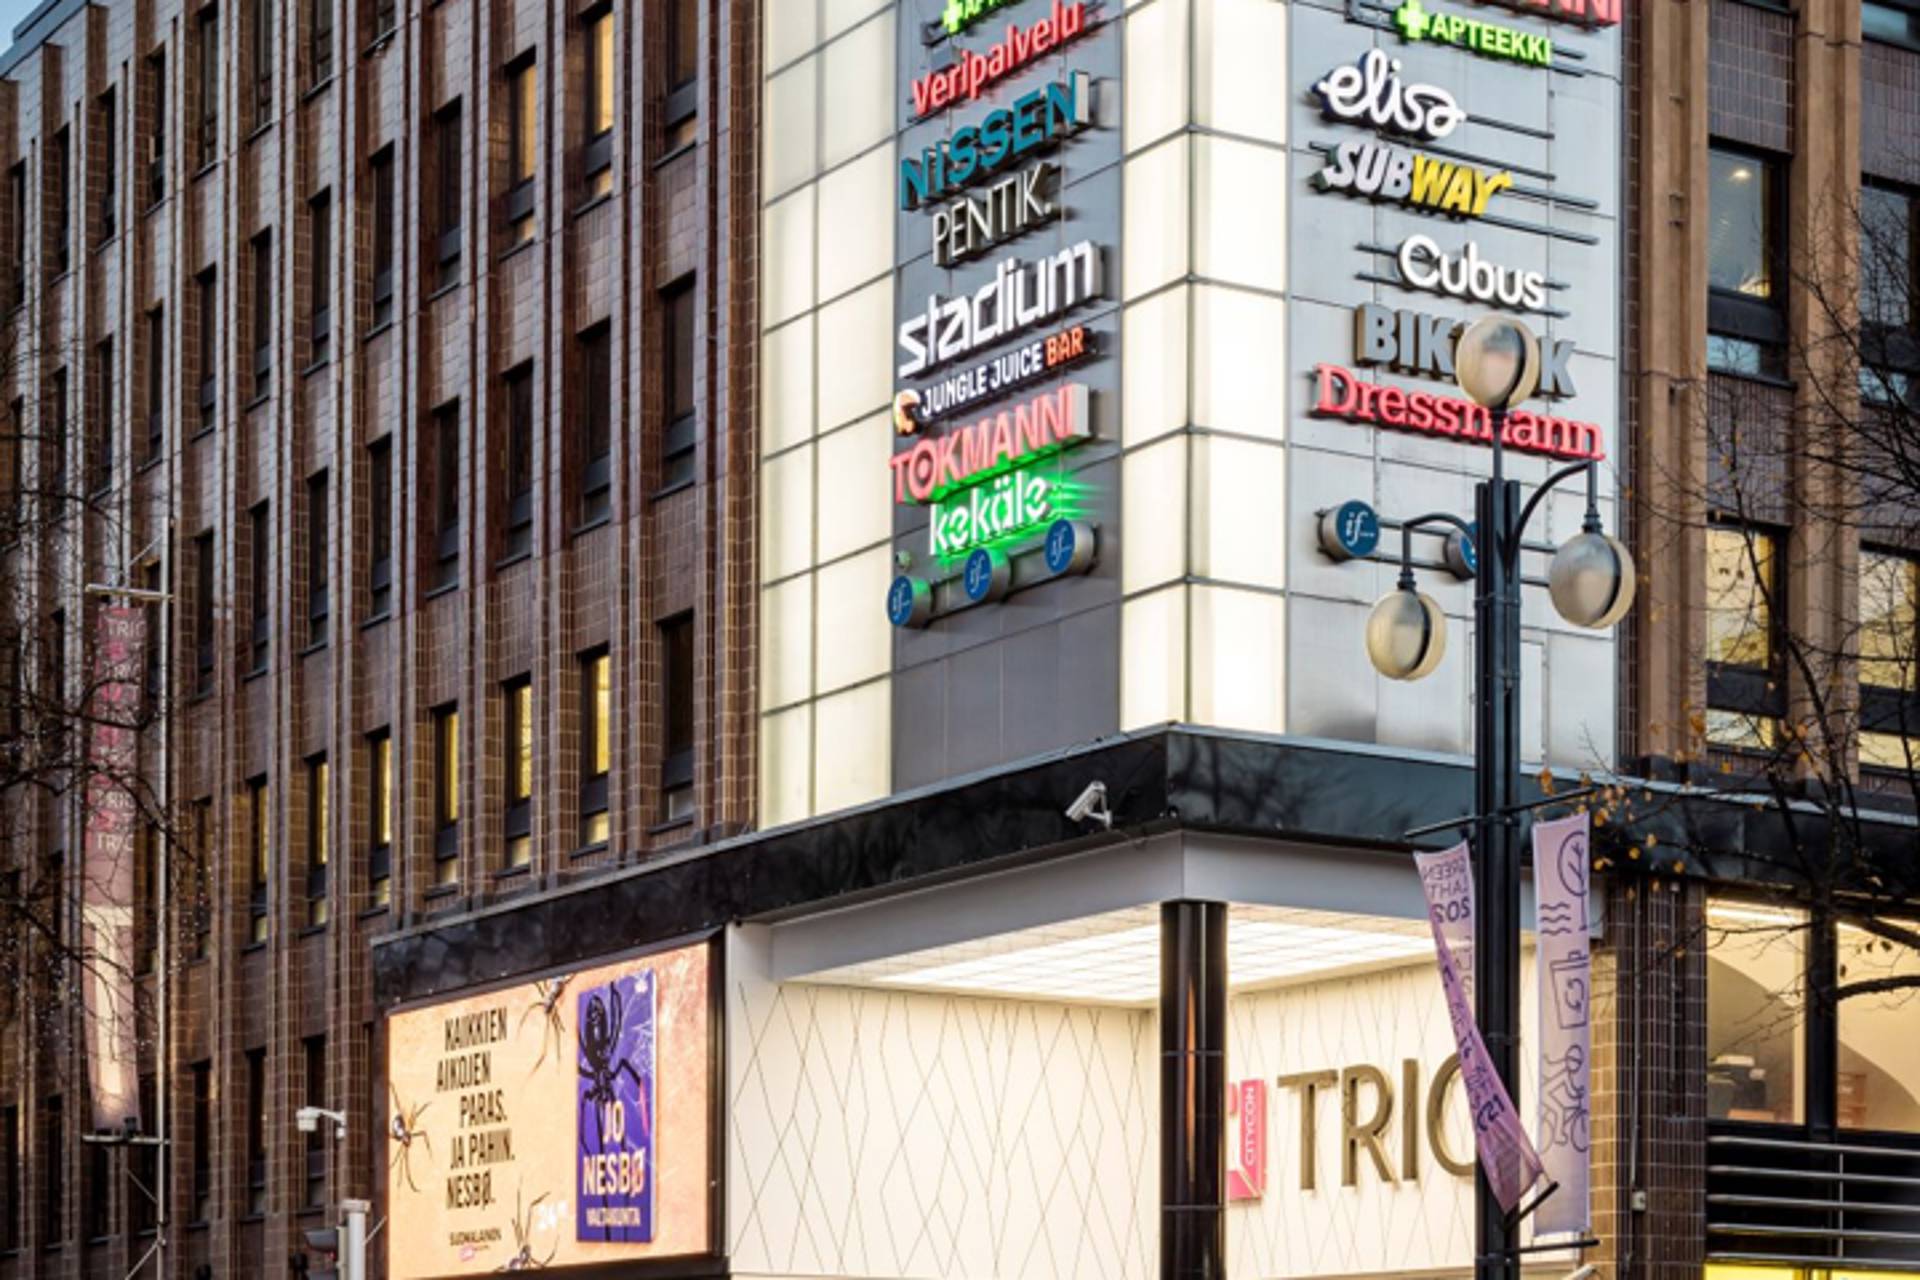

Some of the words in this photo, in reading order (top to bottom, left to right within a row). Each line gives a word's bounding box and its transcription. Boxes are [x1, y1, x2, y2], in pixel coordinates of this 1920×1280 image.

[911, 0, 1086, 116] Veripalvelu
[1430, 12, 1553, 64] APTEEKKI
[1318, 48, 1467, 137] elisa
[901, 69, 1088, 211] NISSEN
[1322, 141, 1513, 217] SUBWAY
[1401, 234, 1546, 309] Cubus
[921, 363, 987, 418] JUNGLE
[989, 343, 1043, 390] JUICE
[1045, 325, 1084, 366] BAR
[890, 383, 1088, 503] TOKMANNI
[930, 470, 1049, 555] kekäle
[436, 1051, 491, 1093] AIKOJEN
[450, 1135, 465, 1170] JA
[603, 1100, 625, 1144] JO
